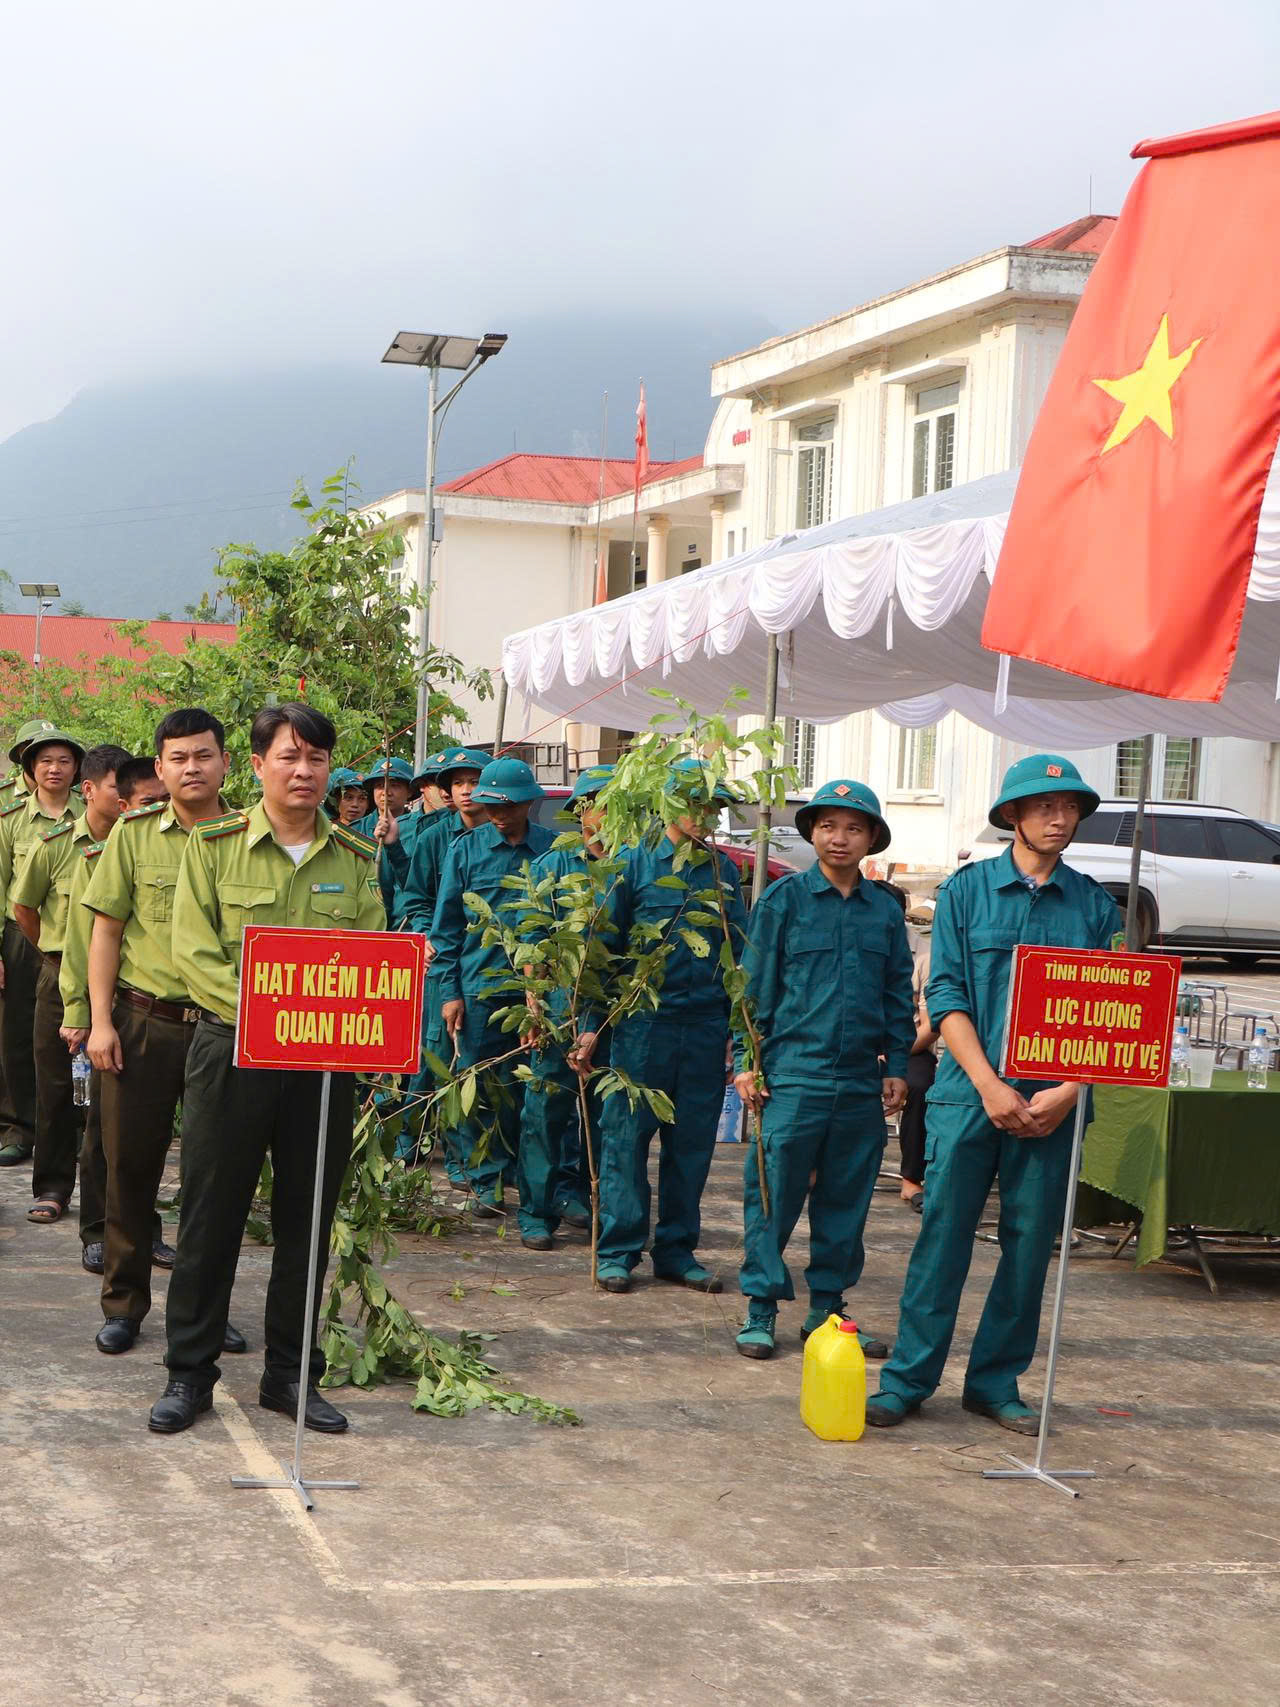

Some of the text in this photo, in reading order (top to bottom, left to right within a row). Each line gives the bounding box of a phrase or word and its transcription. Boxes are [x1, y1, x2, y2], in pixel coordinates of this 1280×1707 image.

[253, 952, 412, 1003] HẠT KIỂM LÂM
[1045, 960, 1152, 987] TÌNH HUỐNG 02
[275, 1006, 385, 1046] QUAN HÓA
[1044, 997, 1142, 1034] LỰC LƯỢNG
[1016, 1031, 1055, 1063] DÂN
[1059, 1035, 1109, 1067] QUÂN
[1113, 1040, 1138, 1073] TỰ
[1139, 1040, 1161, 1076] VỆ
